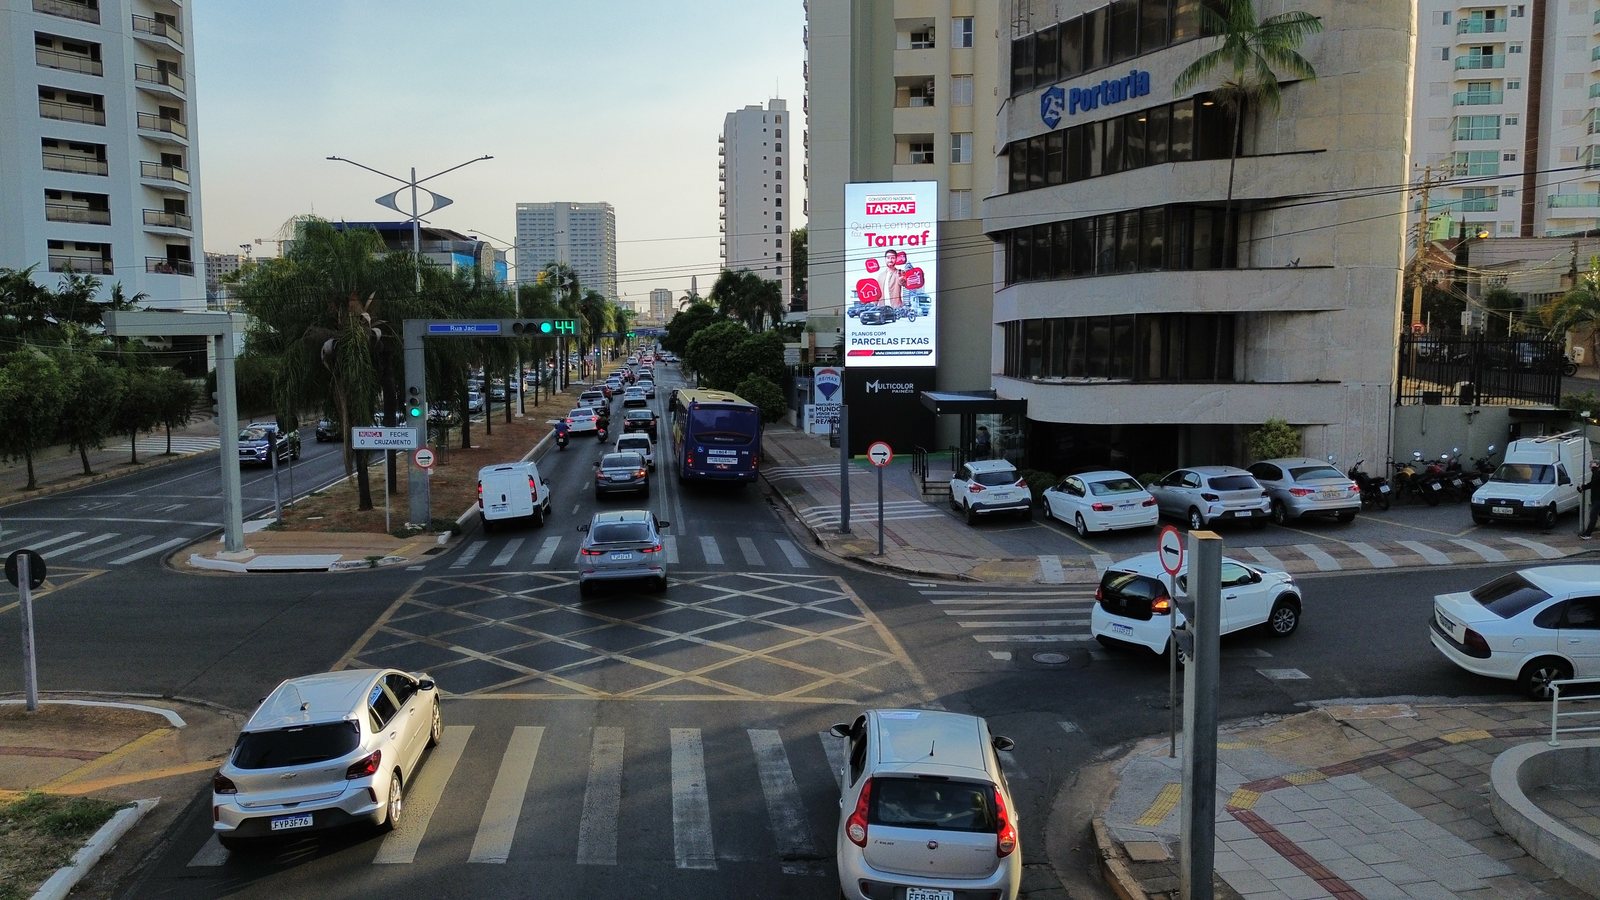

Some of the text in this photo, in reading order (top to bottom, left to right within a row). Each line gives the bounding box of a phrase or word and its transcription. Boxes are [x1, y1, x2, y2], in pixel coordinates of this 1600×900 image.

[1069, 69, 1150, 115] Portaria
[868, 204, 914, 213] TARRAF
[850, 221, 931, 231] Quem compara
[864, 230, 930, 247] Tarraf
[554, 320, 575, 335] 44
[900, 337, 930, 345] FIXAS
[866, 379, 914, 394] MULTICOLOR
[274, 818, 309, 829] FYP3F76
